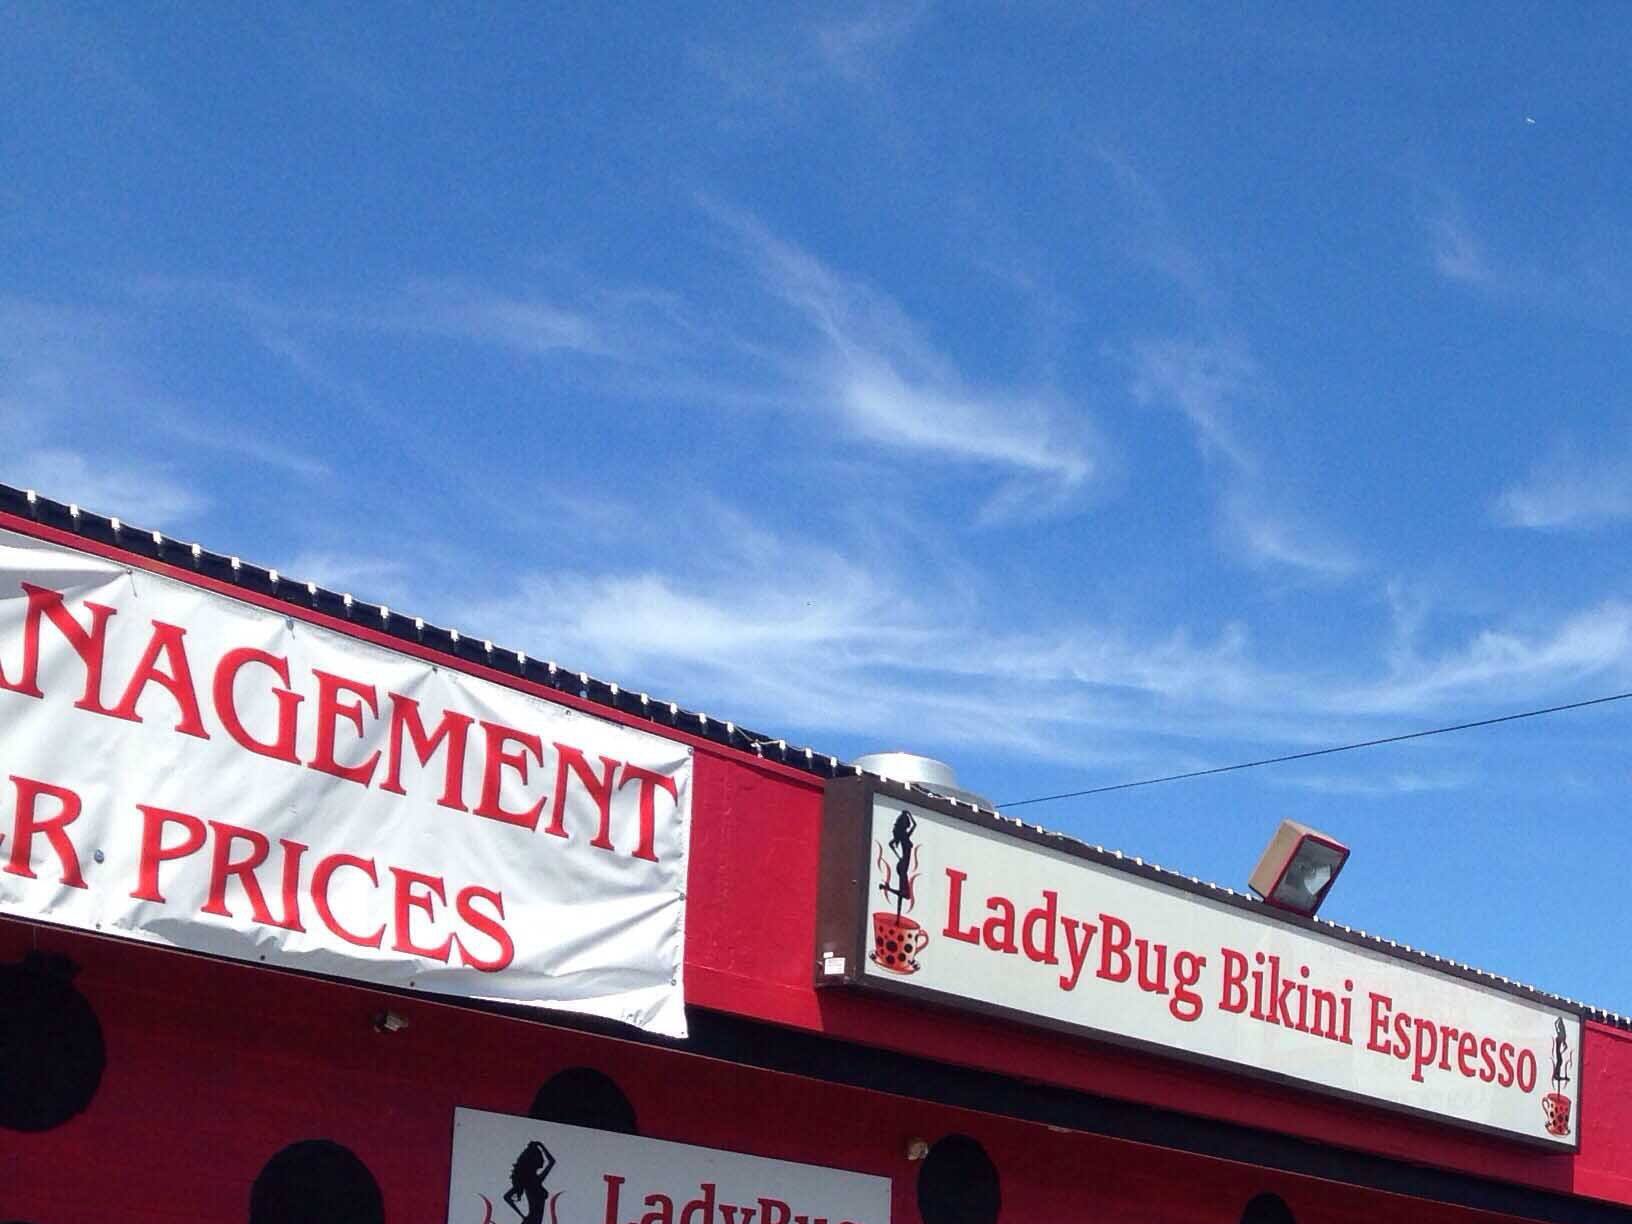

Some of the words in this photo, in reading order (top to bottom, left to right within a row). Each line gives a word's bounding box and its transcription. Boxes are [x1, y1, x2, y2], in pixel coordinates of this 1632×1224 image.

[0, 582, 679, 863] NAGEMENT
[0, 775, 89, 889] R
[130, 804, 515, 973] PRICES
[943, 867, 1206, 1021] LadyBug
[1218, 947, 1354, 1045] Bikini
[1366, 992, 1538, 1093] Espresso
